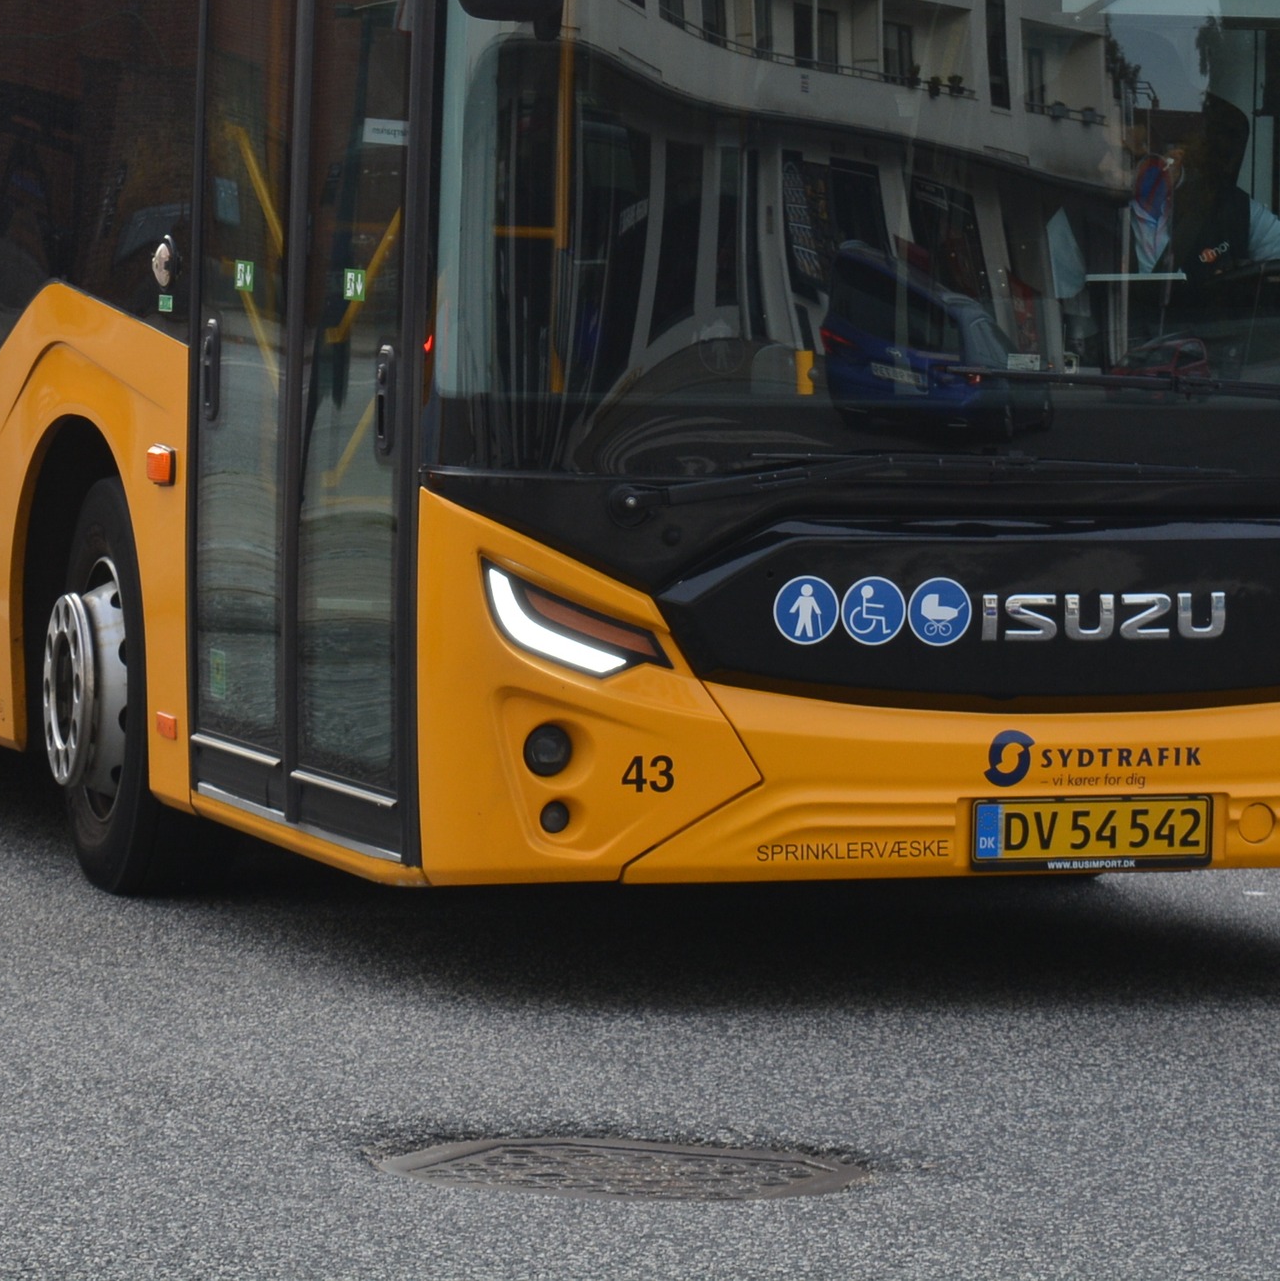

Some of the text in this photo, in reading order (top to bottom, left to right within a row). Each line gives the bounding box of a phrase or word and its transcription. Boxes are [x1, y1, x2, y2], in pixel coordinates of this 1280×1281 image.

[981, 591, 1227, 641] ISUZU
[1040, 747, 1202, 769] SYDTRAFIK
[621, 755, 675, 794] 43
[1052, 774, 1063, 786] vi
[1067, 774, 1100, 786] kører
[1104, 773, 1121, 786] for
[1125, 773, 1146, 789] dig
[979, 807, 1201, 851] DK DV 54 542
[756, 840, 950, 862] SPRINKLERVÆSKE
[1047, 859, 1136, 870] WWW.BUSIMPORT.DK
